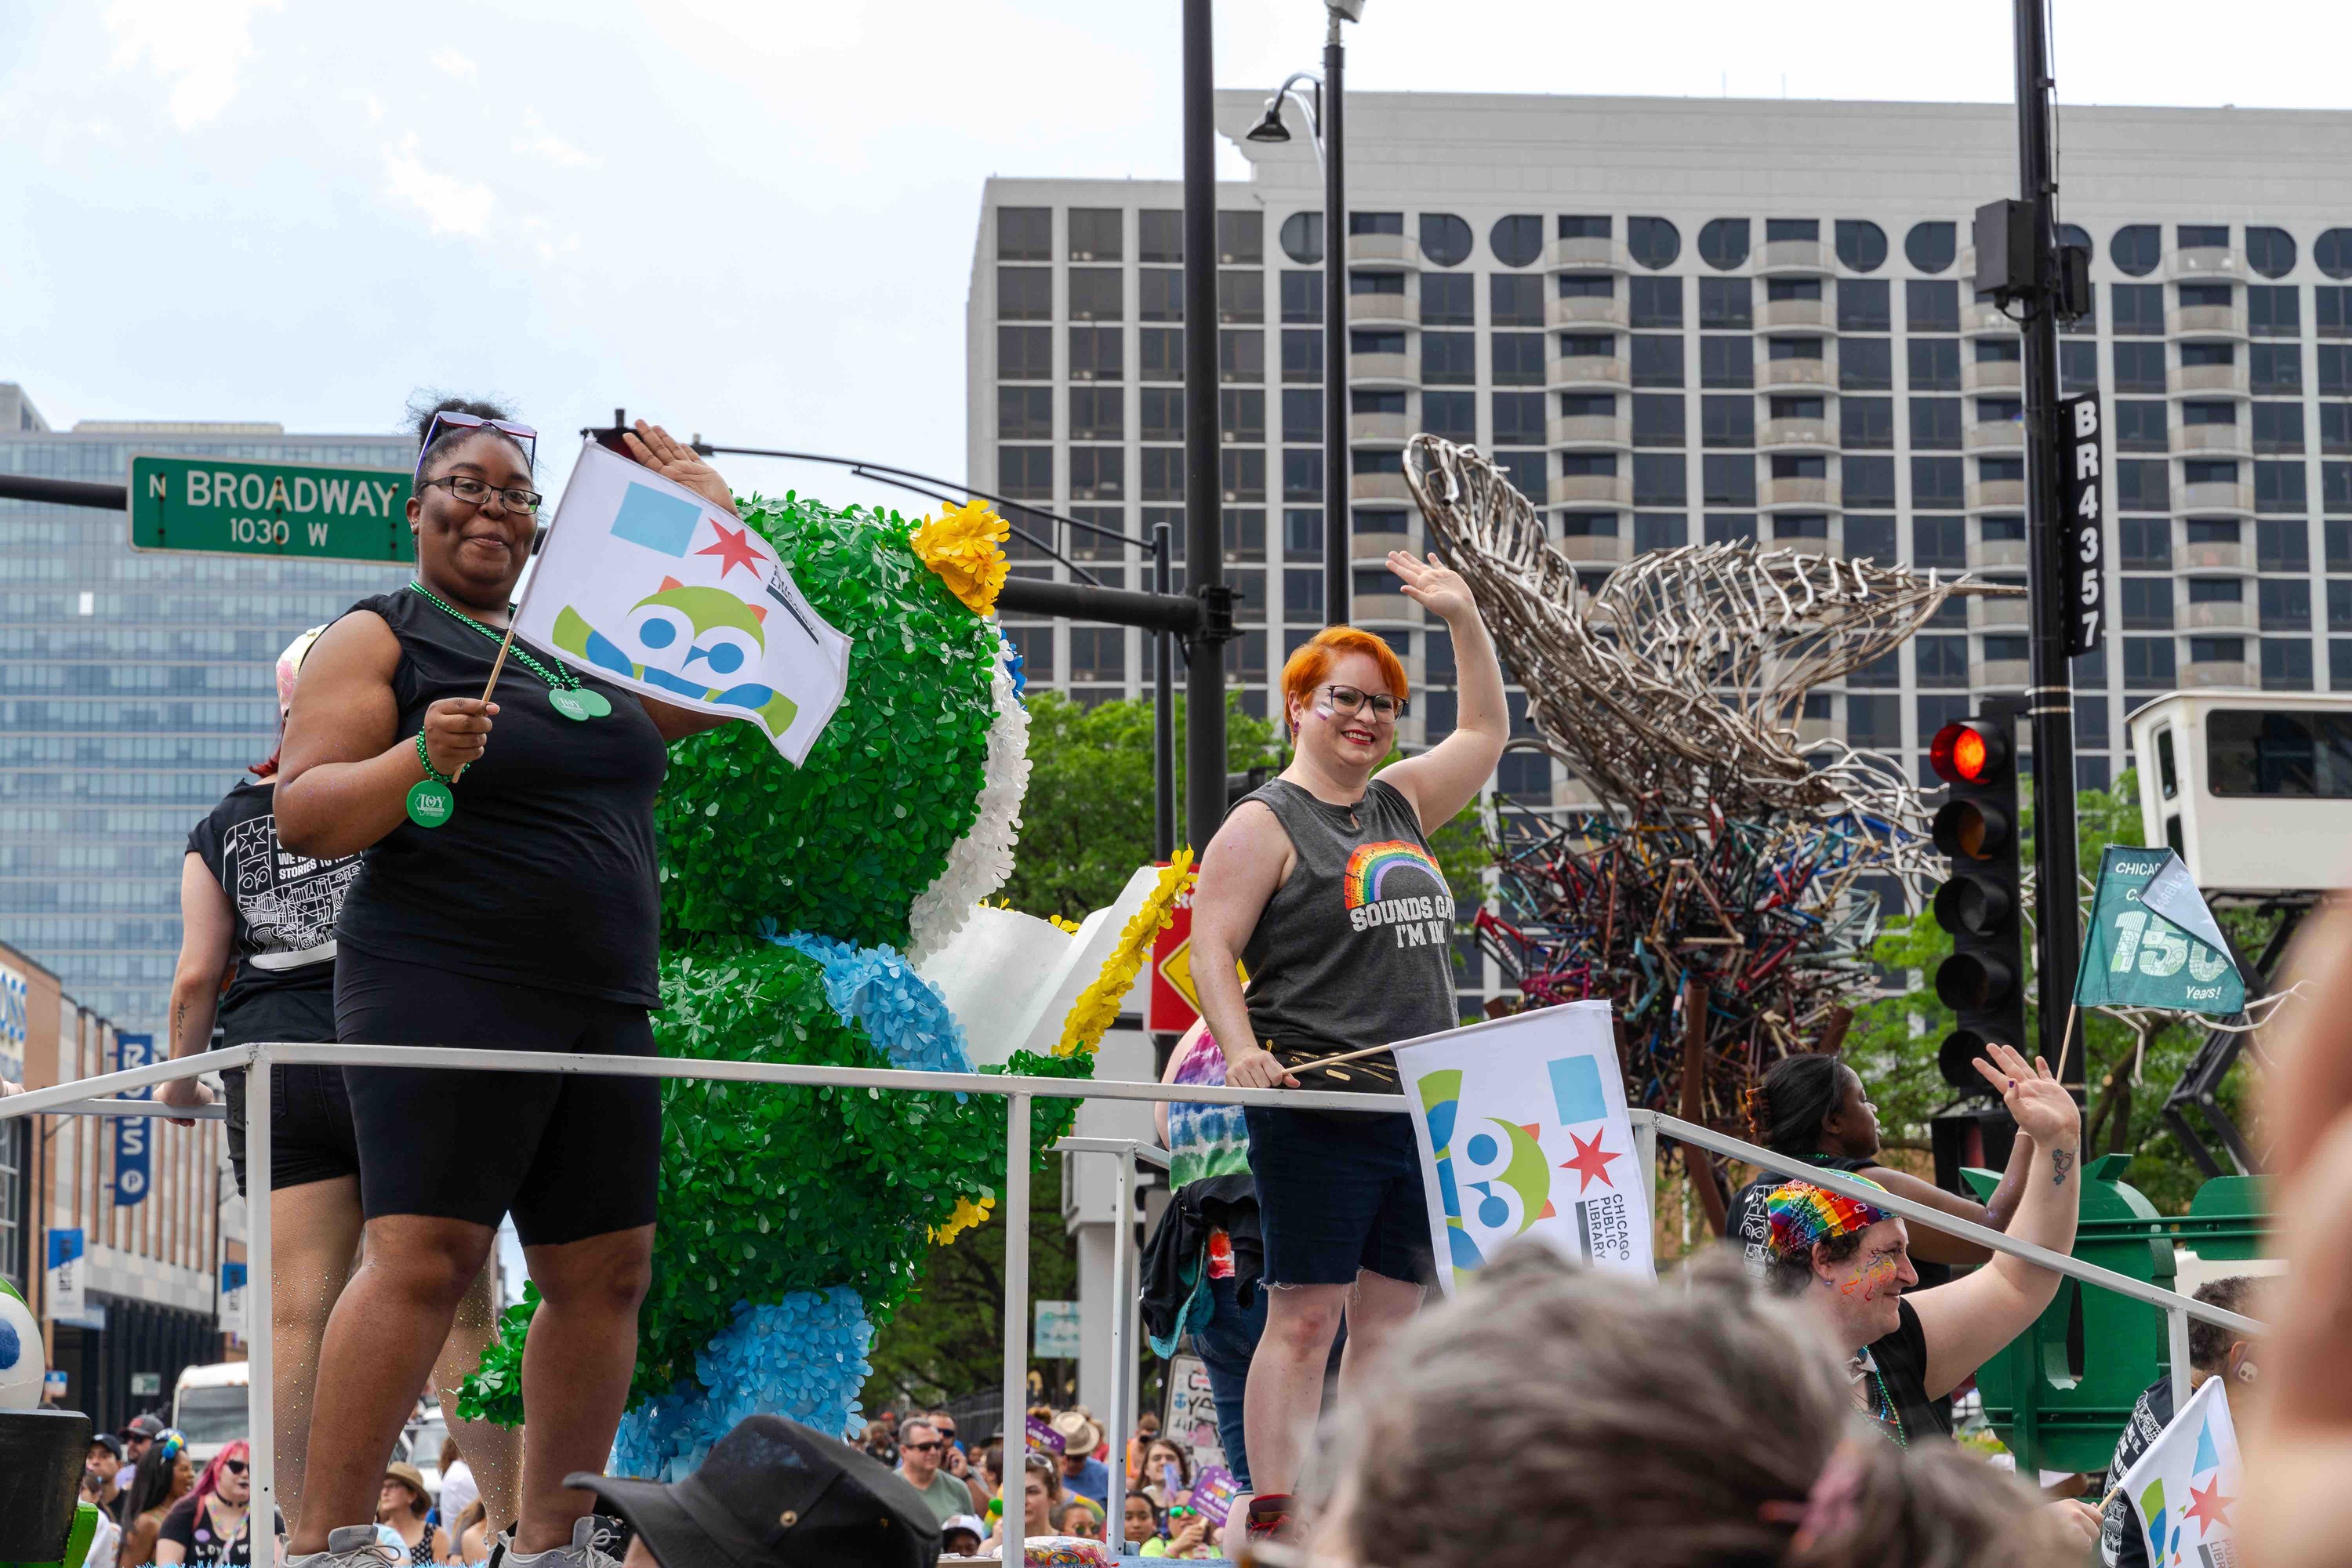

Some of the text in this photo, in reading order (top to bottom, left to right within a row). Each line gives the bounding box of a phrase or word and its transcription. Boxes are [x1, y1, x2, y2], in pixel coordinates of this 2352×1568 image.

[148, 470, 400, 517] N BROADWAY
[230, 517, 328, 547] 1030 W
[278, 858, 318, 880] STORIES
[2114, 862, 2162, 876] CHICA
[1349, 895, 1456, 932] SOUNDS GAY
[1395, 920, 1446, 949] I'M IN
[2185, 985, 2222, 1000] Years!
[1588, 1199, 1606, 1259] LIBRARY
[1600, 1196, 1617, 1250] PUBLIC
[1613, 1193, 1630, 1261] CHICAGO
[2209, 1541, 2227, 1568] LIBR
